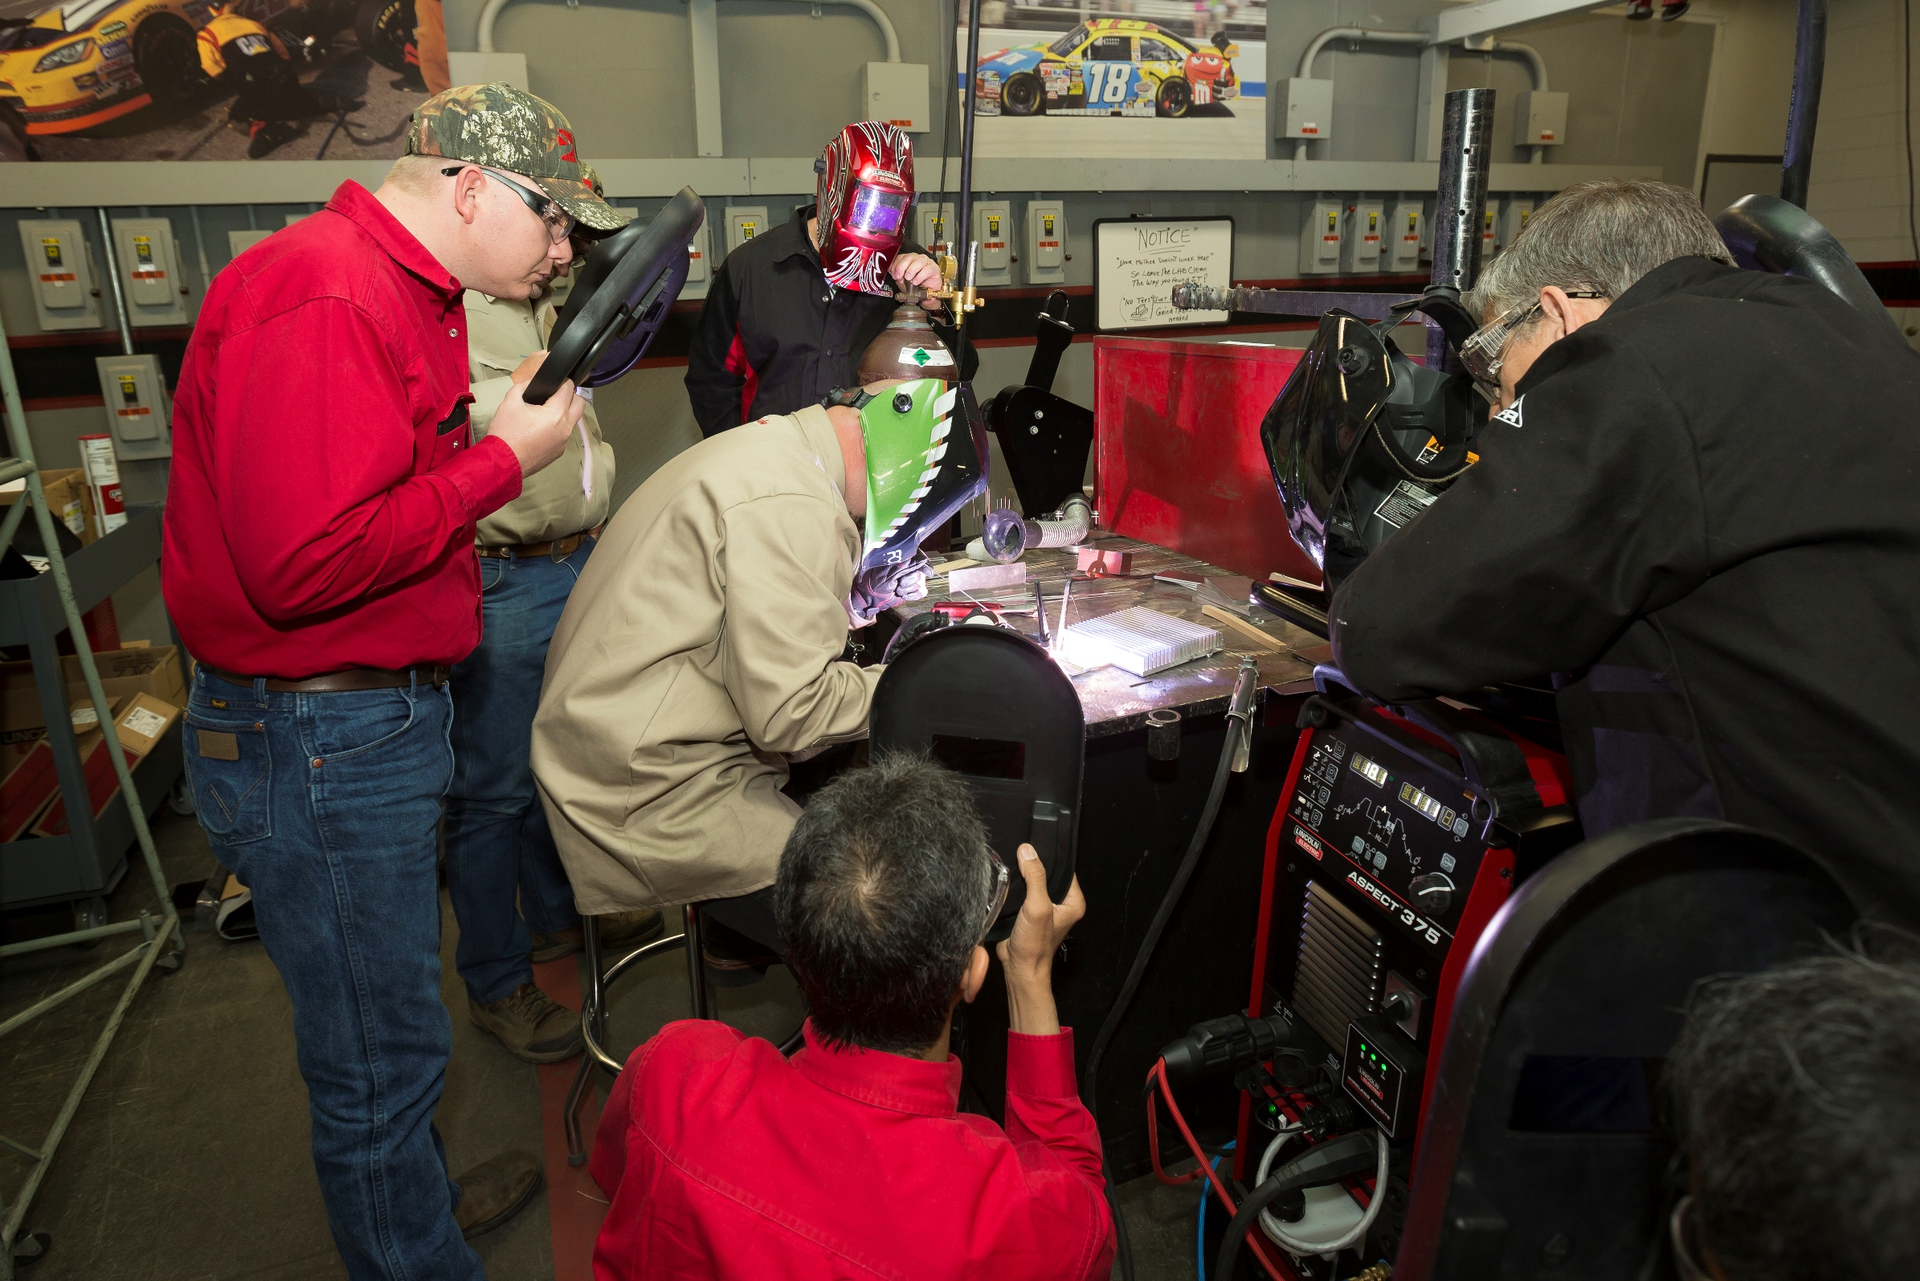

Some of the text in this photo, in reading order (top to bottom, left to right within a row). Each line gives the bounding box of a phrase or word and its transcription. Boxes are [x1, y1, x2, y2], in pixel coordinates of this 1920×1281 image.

[1088, 63, 1132, 103] 18
[1295, 827, 1320, 850] LINCOLN
[1347, 871, 1400, 911] ASPECT
[1400, 908, 1441, 945] 375
